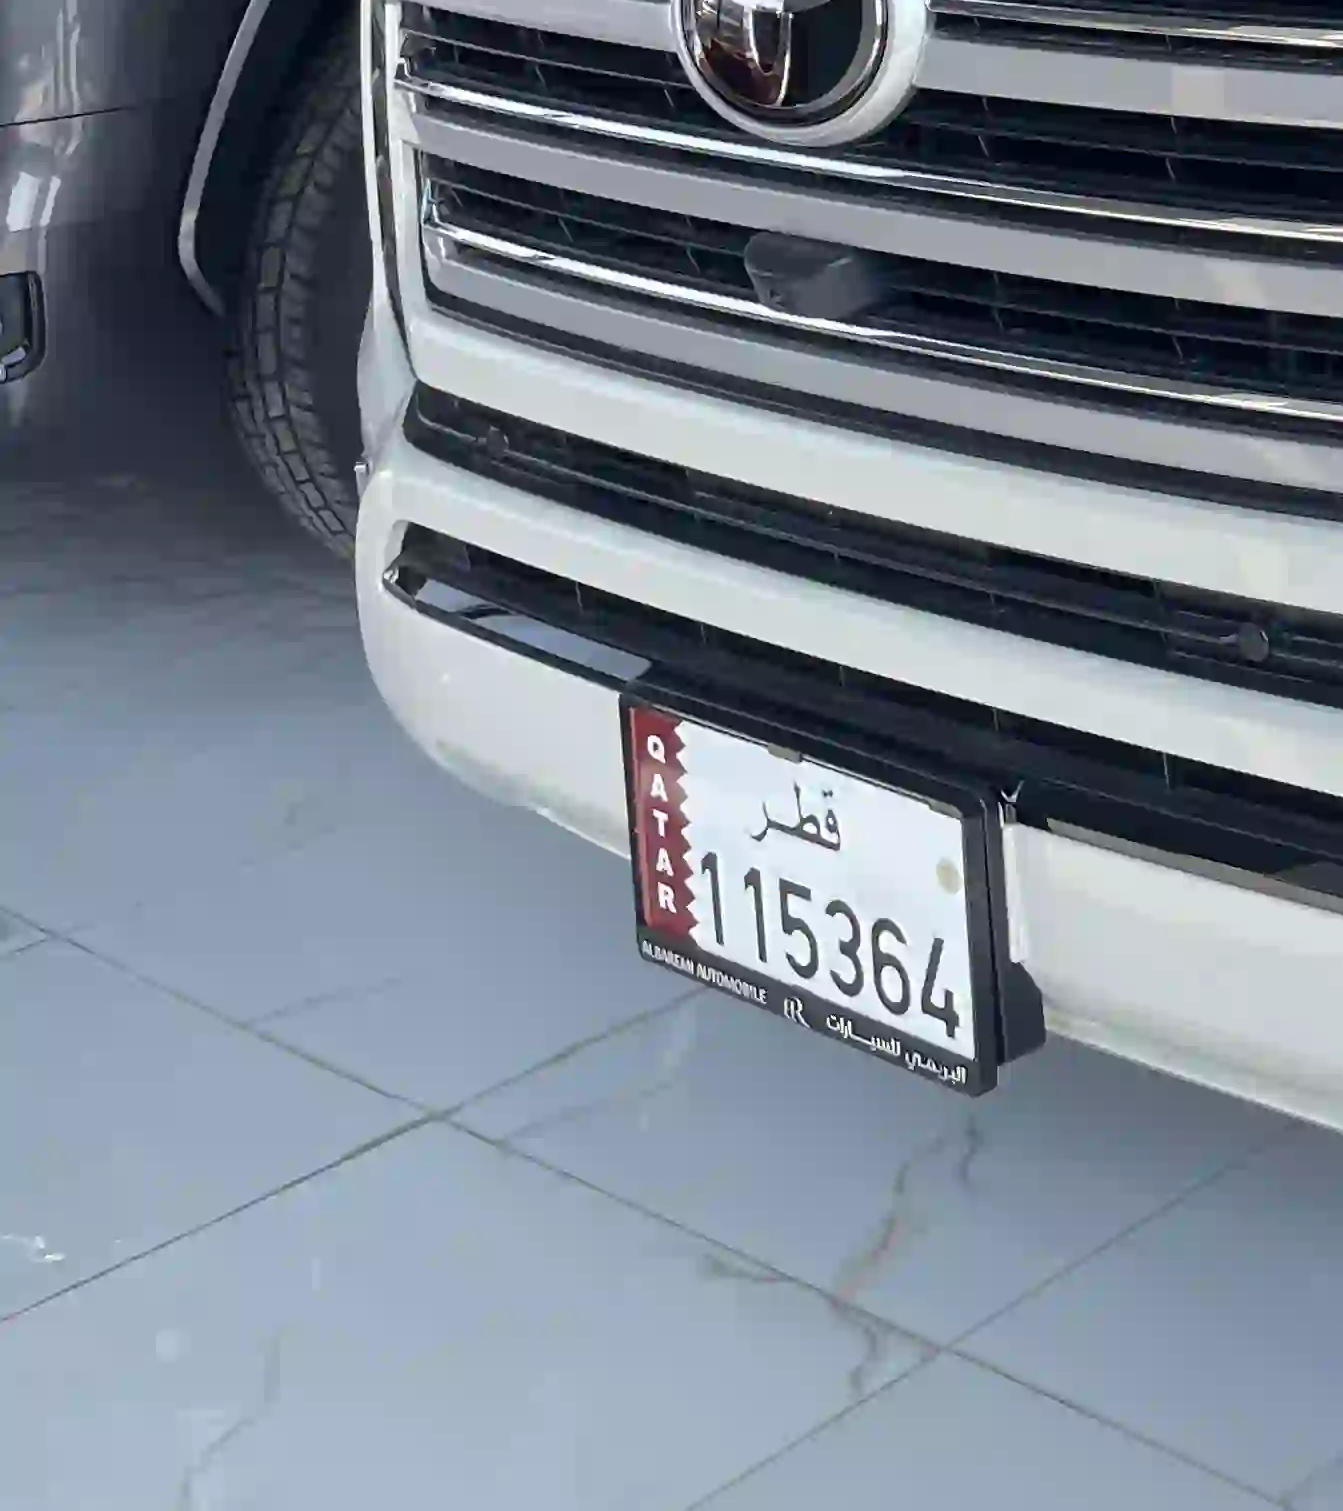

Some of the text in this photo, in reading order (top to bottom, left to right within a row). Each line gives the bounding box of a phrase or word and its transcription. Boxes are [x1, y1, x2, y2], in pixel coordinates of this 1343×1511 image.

[646, 733, 677, 915] QATAR
[750, 780, 842, 852] قطر
[696, 963, 769, 1005] AUTOMOBILE
[700, 851, 961, 1040] 115364
